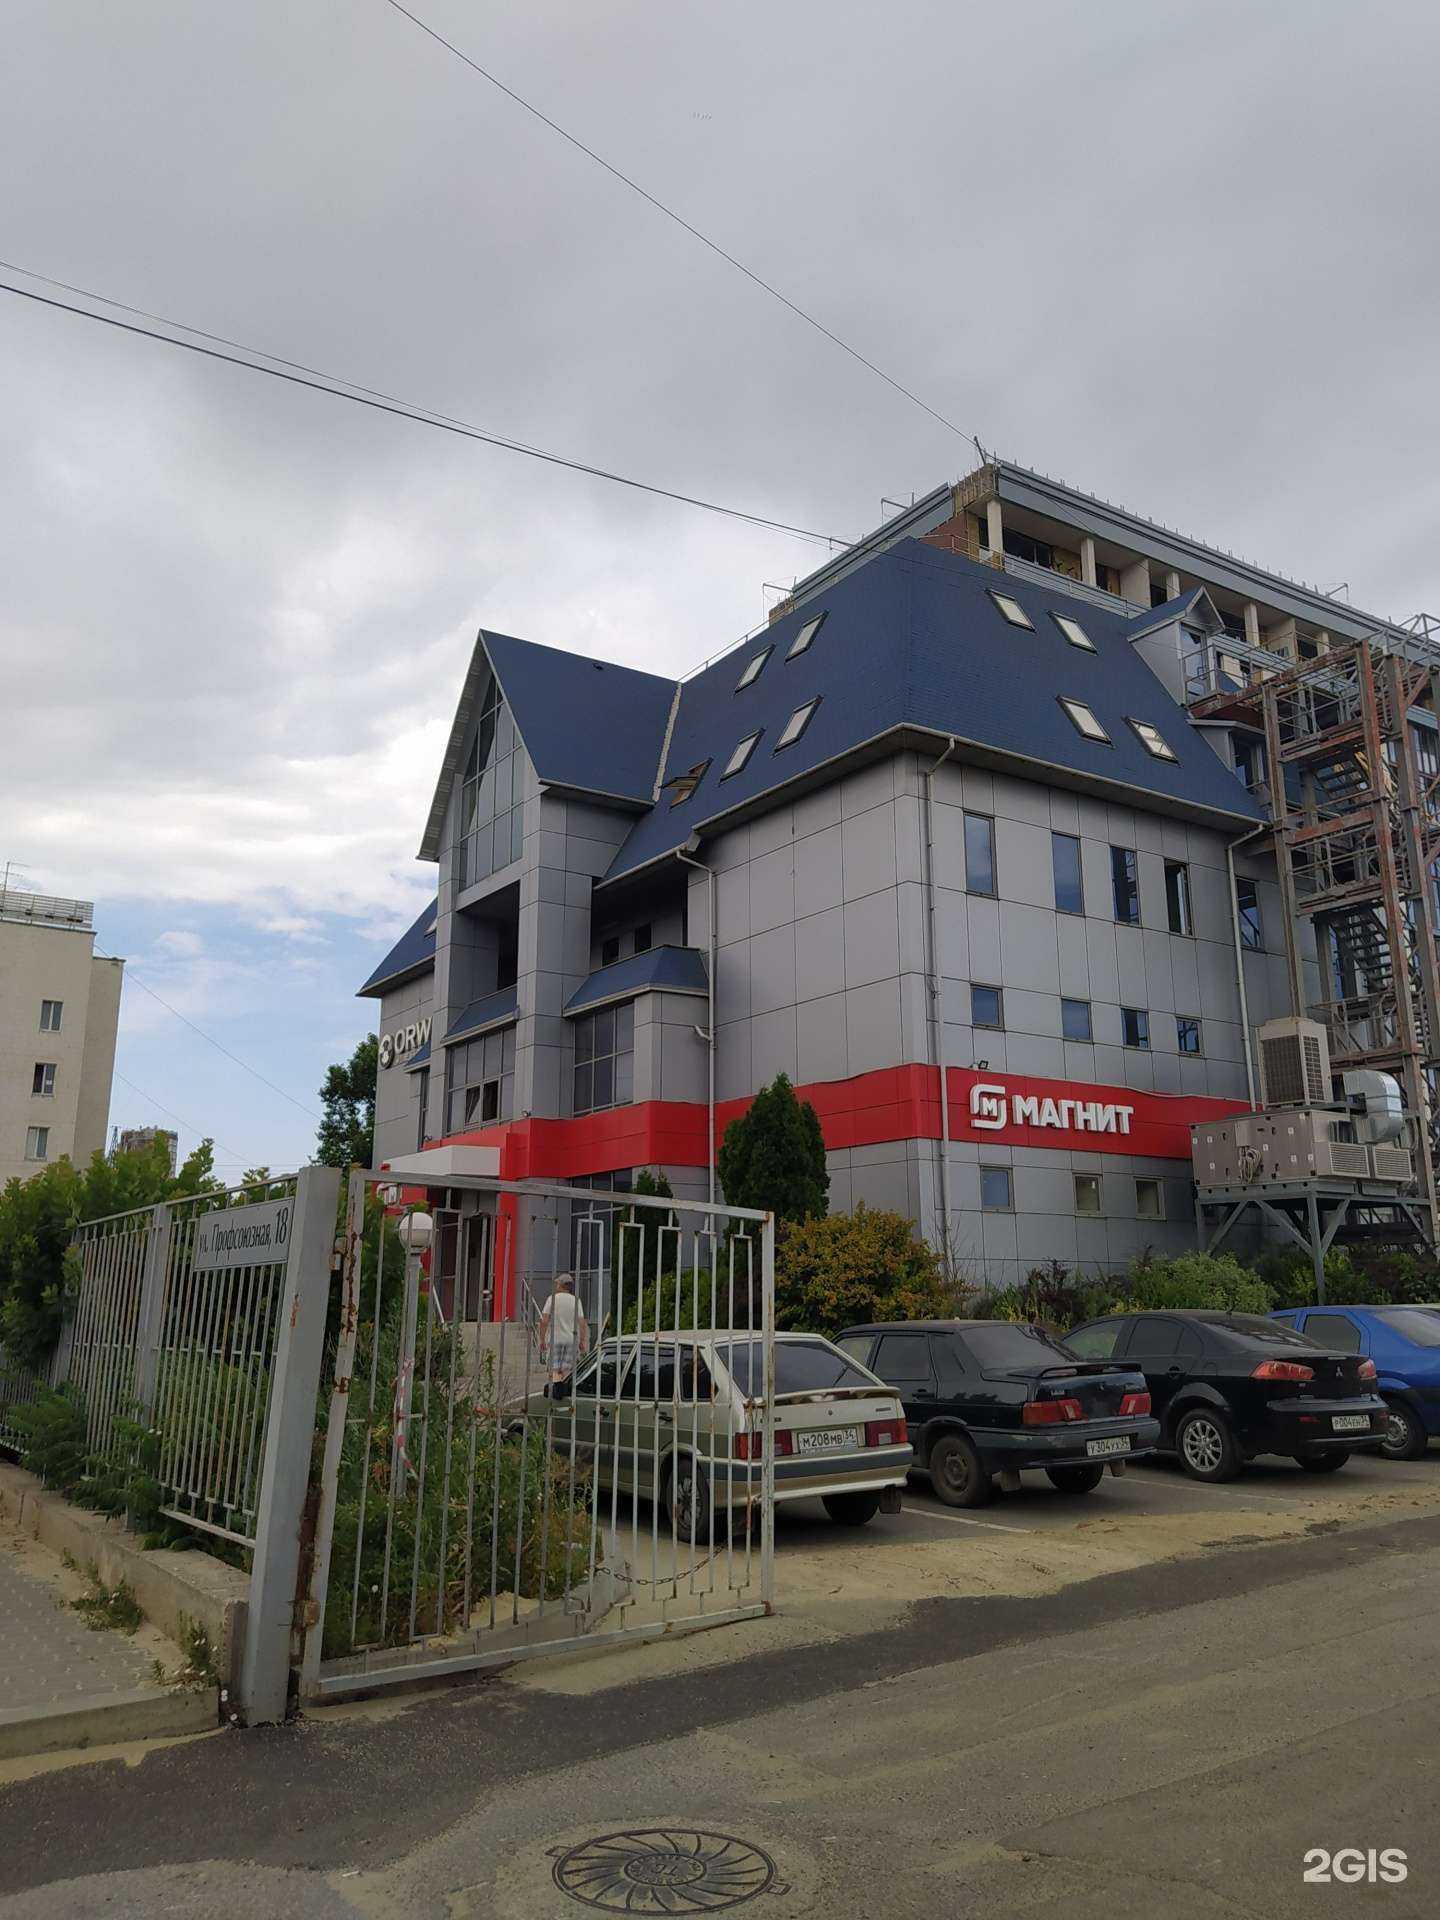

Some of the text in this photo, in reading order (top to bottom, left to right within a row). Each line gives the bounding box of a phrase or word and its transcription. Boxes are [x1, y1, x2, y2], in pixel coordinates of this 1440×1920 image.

[1012, 1094, 1134, 1135] МАГНИТ
[211, 1218, 272, 1262] Профсоюзная,
[275, 1207, 289, 1244] 18
